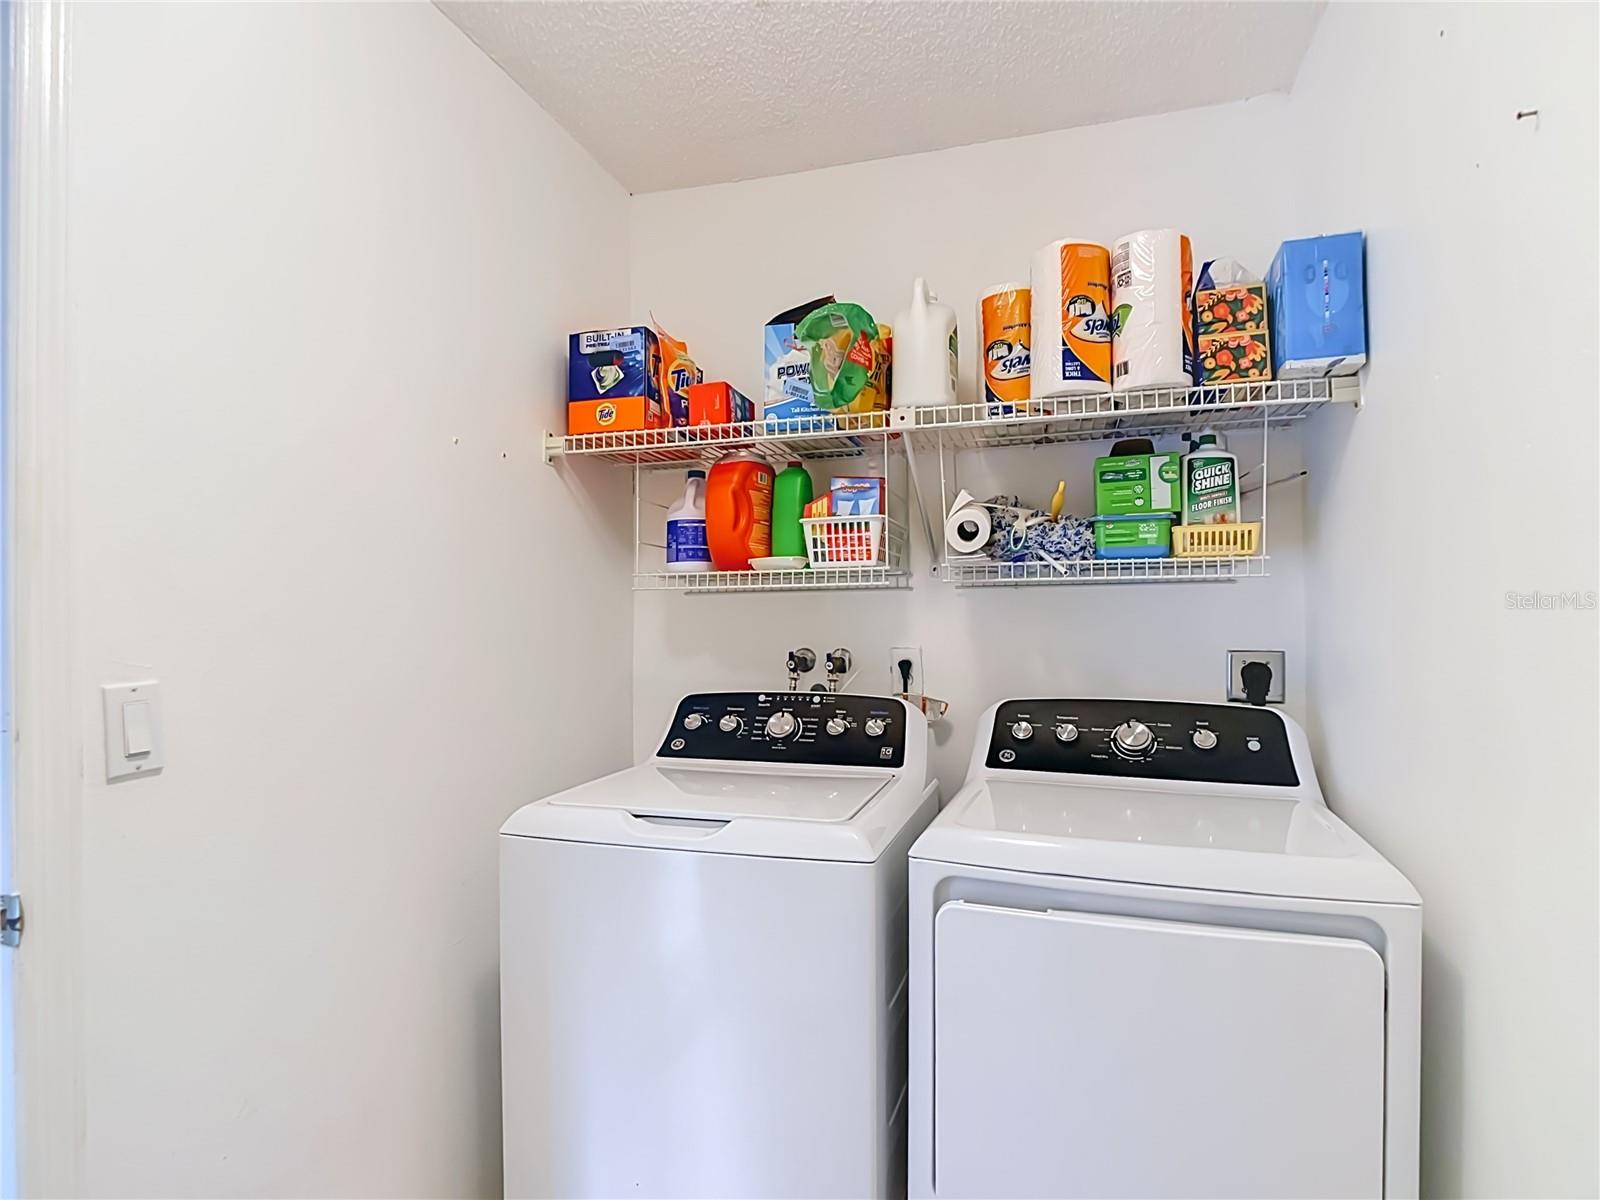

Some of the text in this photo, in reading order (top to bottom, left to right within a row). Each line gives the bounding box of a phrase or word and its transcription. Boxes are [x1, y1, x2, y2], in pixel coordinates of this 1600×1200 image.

[598, 408, 614, 421] Tide
[1195, 463, 1230, 480] QUICK
[1195, 473, 1230, 491] SHINE
[1191, 496, 1233, 512] FLOOR FINISH
